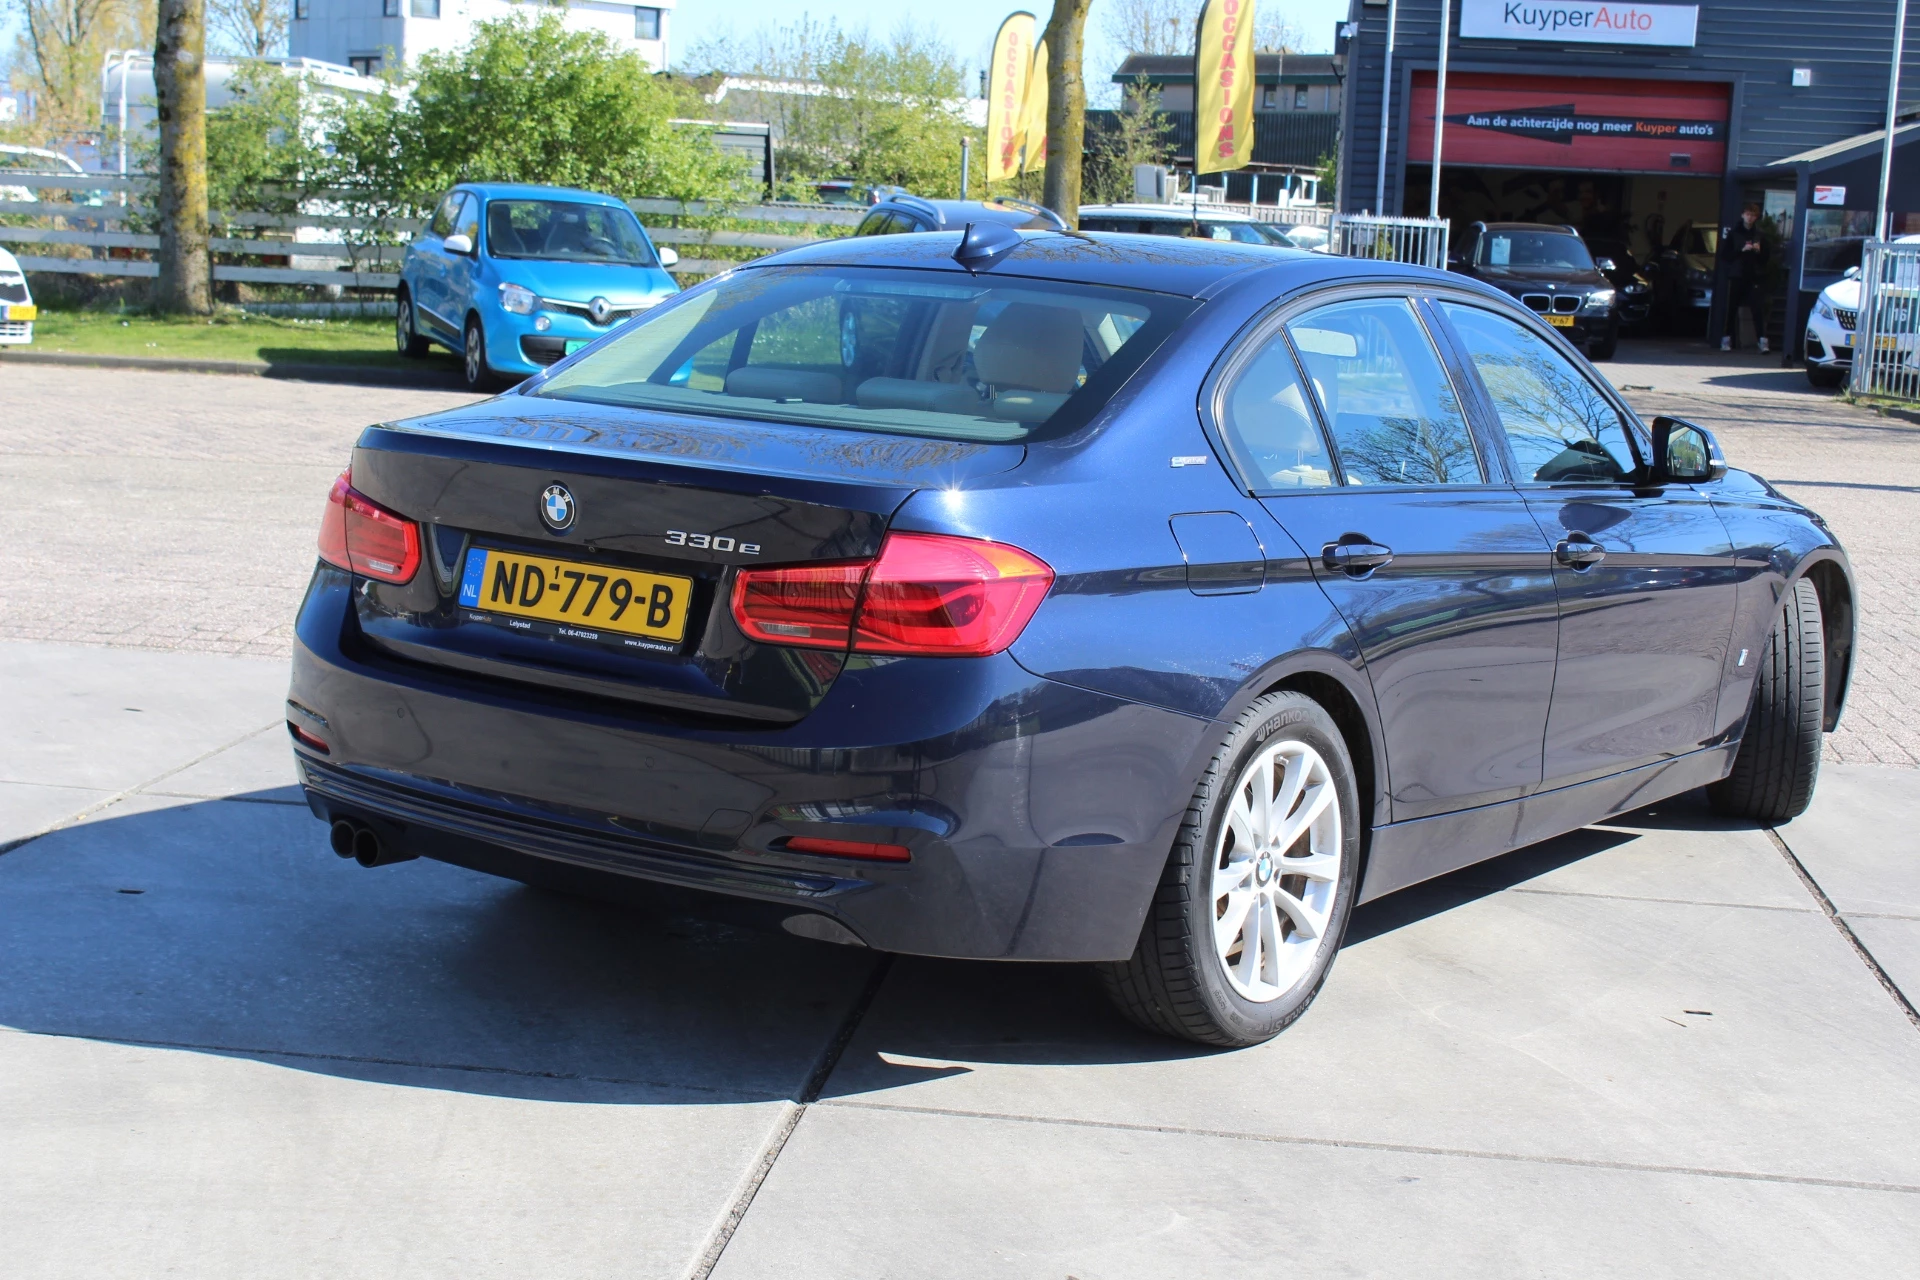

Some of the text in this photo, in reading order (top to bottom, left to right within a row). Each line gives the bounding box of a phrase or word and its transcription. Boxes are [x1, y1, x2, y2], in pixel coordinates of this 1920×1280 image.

[1503, 2, 1653, 31] KuyperAuto
[1218, 0, 1238, 157] OCCASIONS
[1466, 115, 1714, 135] Aan de achterzijde nog meer Kuyper auto's
[543, 487, 572, 503] BMW
[664, 529, 761, 555] 330e
[462, 583, 477, 598] NL
[490, 560, 673, 629] ND-779-B
[509, 620, 532, 629] Lelystad
